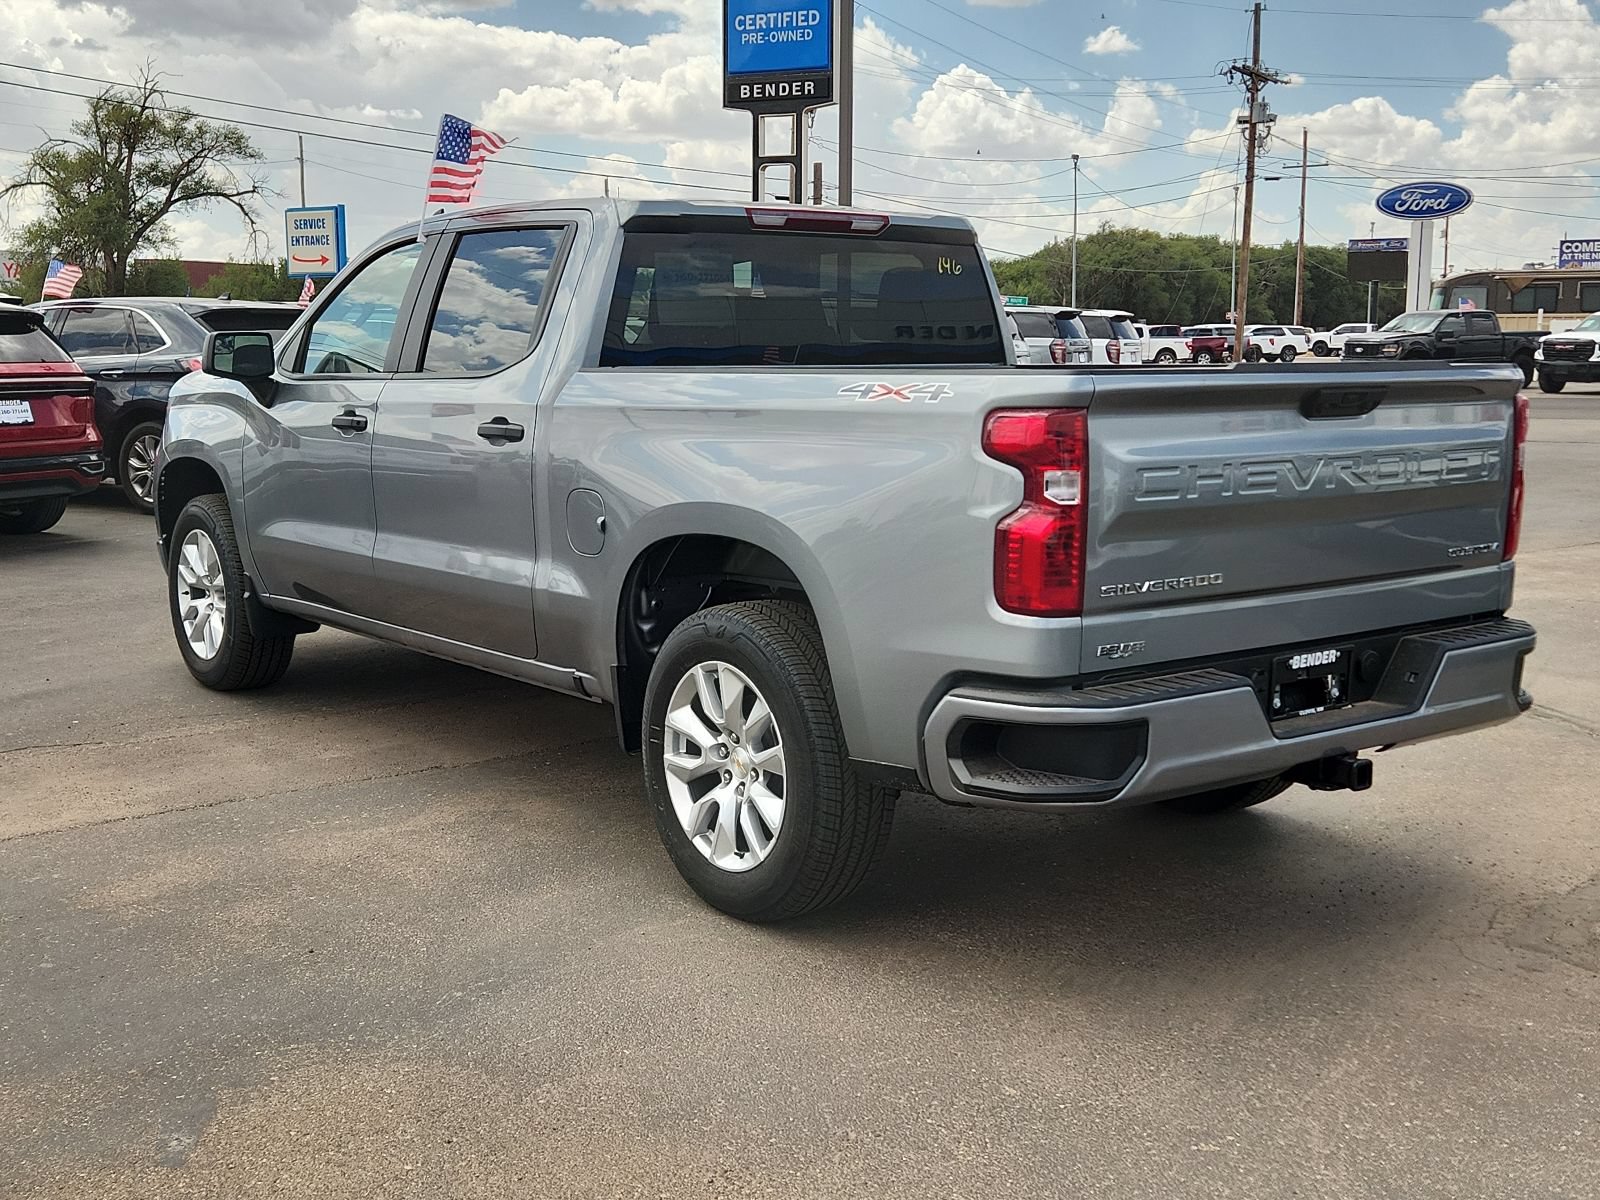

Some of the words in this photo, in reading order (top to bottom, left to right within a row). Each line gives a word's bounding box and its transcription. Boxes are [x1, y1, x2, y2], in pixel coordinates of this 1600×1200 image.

[735, 10, 820, 31] CERTIFIED
[741, 29, 813, 45] PRE-OWNED
[740, 81, 815, 99] BENDER
[1394, 188, 1452, 212] Ford
[294, 218, 326, 230] SERVICE
[291, 234, 331, 246] ENTRANCE
[937, 256, 963, 275] 146
[1573, 252, 1591, 260] THE
[1591, 252, 1600, 260] N
[1134, 449, 1500, 501] CHEVROLET
[1100, 573, 1224, 597] SILVERADO
[1291, 649, 1337, 670] BENDER
